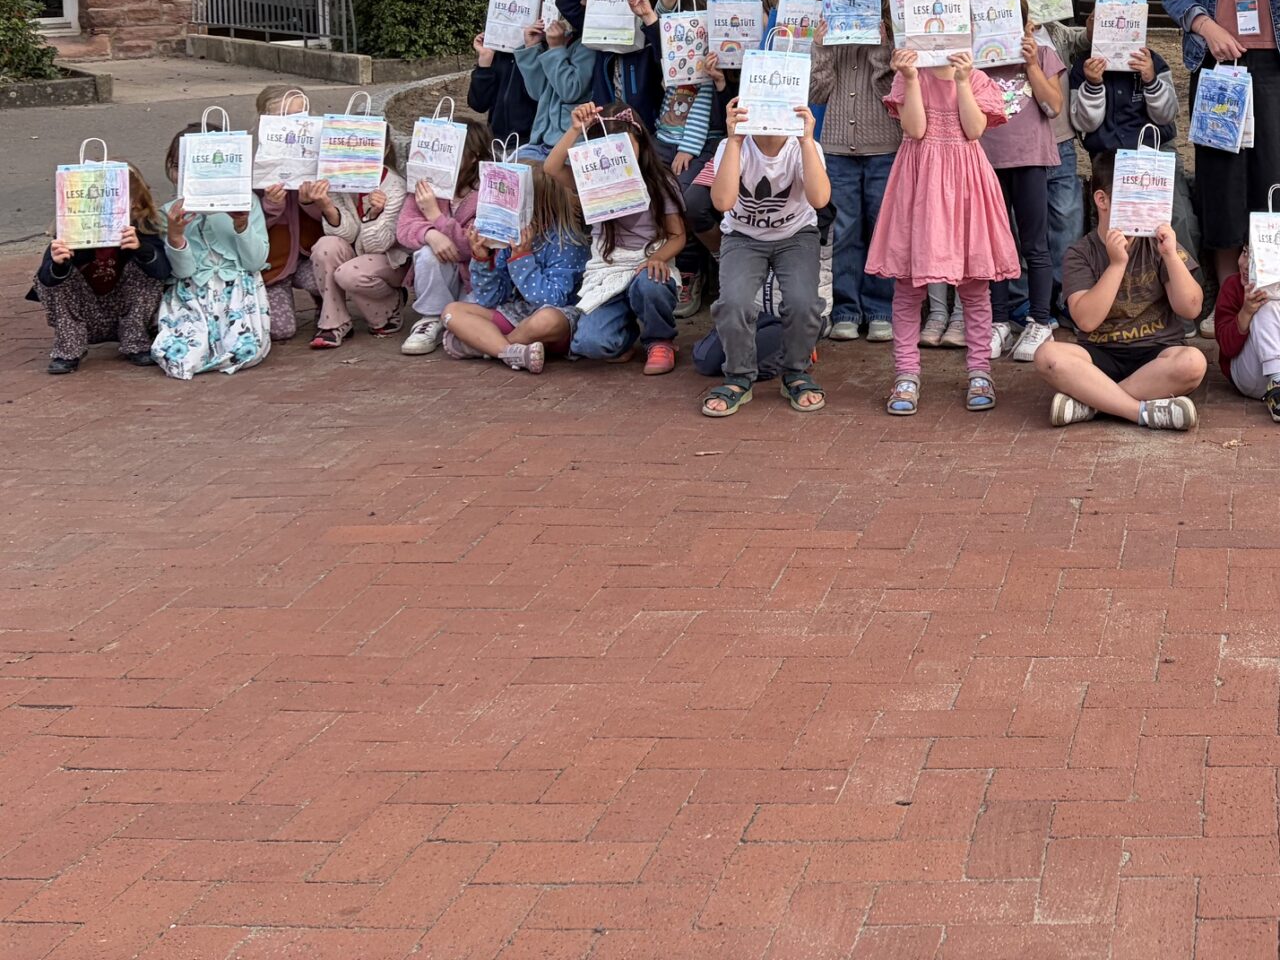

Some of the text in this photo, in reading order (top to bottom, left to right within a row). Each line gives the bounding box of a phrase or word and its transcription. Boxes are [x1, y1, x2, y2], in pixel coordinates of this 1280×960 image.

[913, 3, 961, 15] LESE TÜTE
[972, 13, 985, 22] ESE
[750, 74, 801, 86] LESE TÜTE
[267, 134, 282, 142] LESE
[192, 155, 210, 164] LESE
[581, 163, 598, 173] LESE
[1122, 176, 1138, 185] LESE
[729, 209, 796, 229] adidas
[1088, 320, 1165, 343] BATMAN
